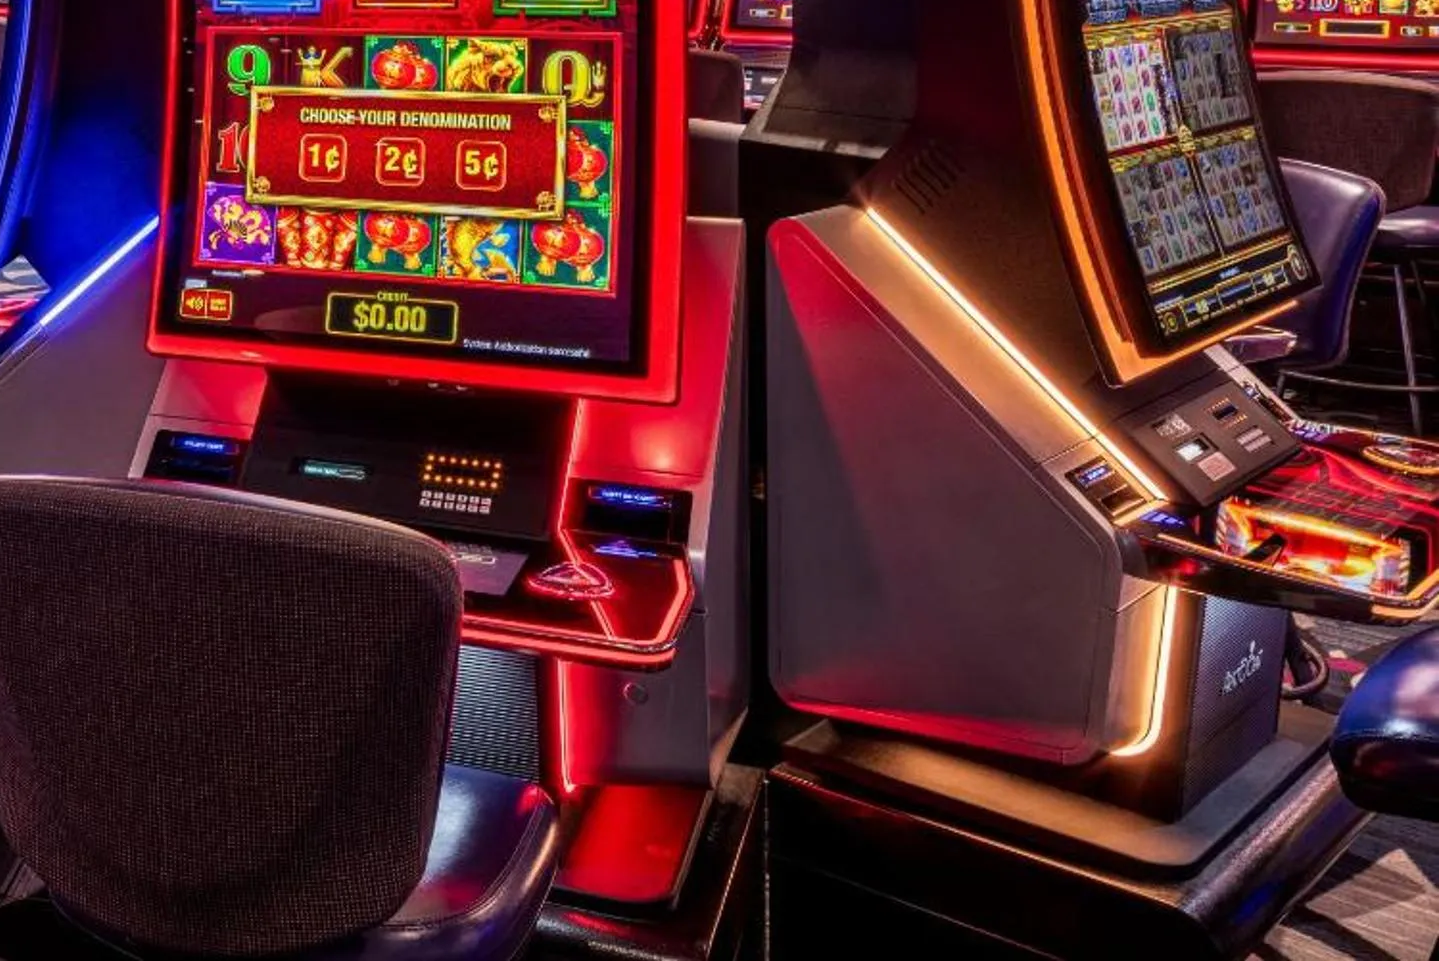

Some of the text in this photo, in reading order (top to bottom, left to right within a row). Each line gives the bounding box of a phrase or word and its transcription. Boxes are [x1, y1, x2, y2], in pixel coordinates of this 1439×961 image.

[227, 44, 271, 96] 9
[543, 50, 607, 107] Q
[300, 107, 511, 131] CHOOSE YOUR DENOMINATION
[307, 143, 341, 173] 1¢
[384, 146, 418, 176] 2¢
[464, 150, 499, 180] 5¢
[353, 302, 427, 334] $0.00
